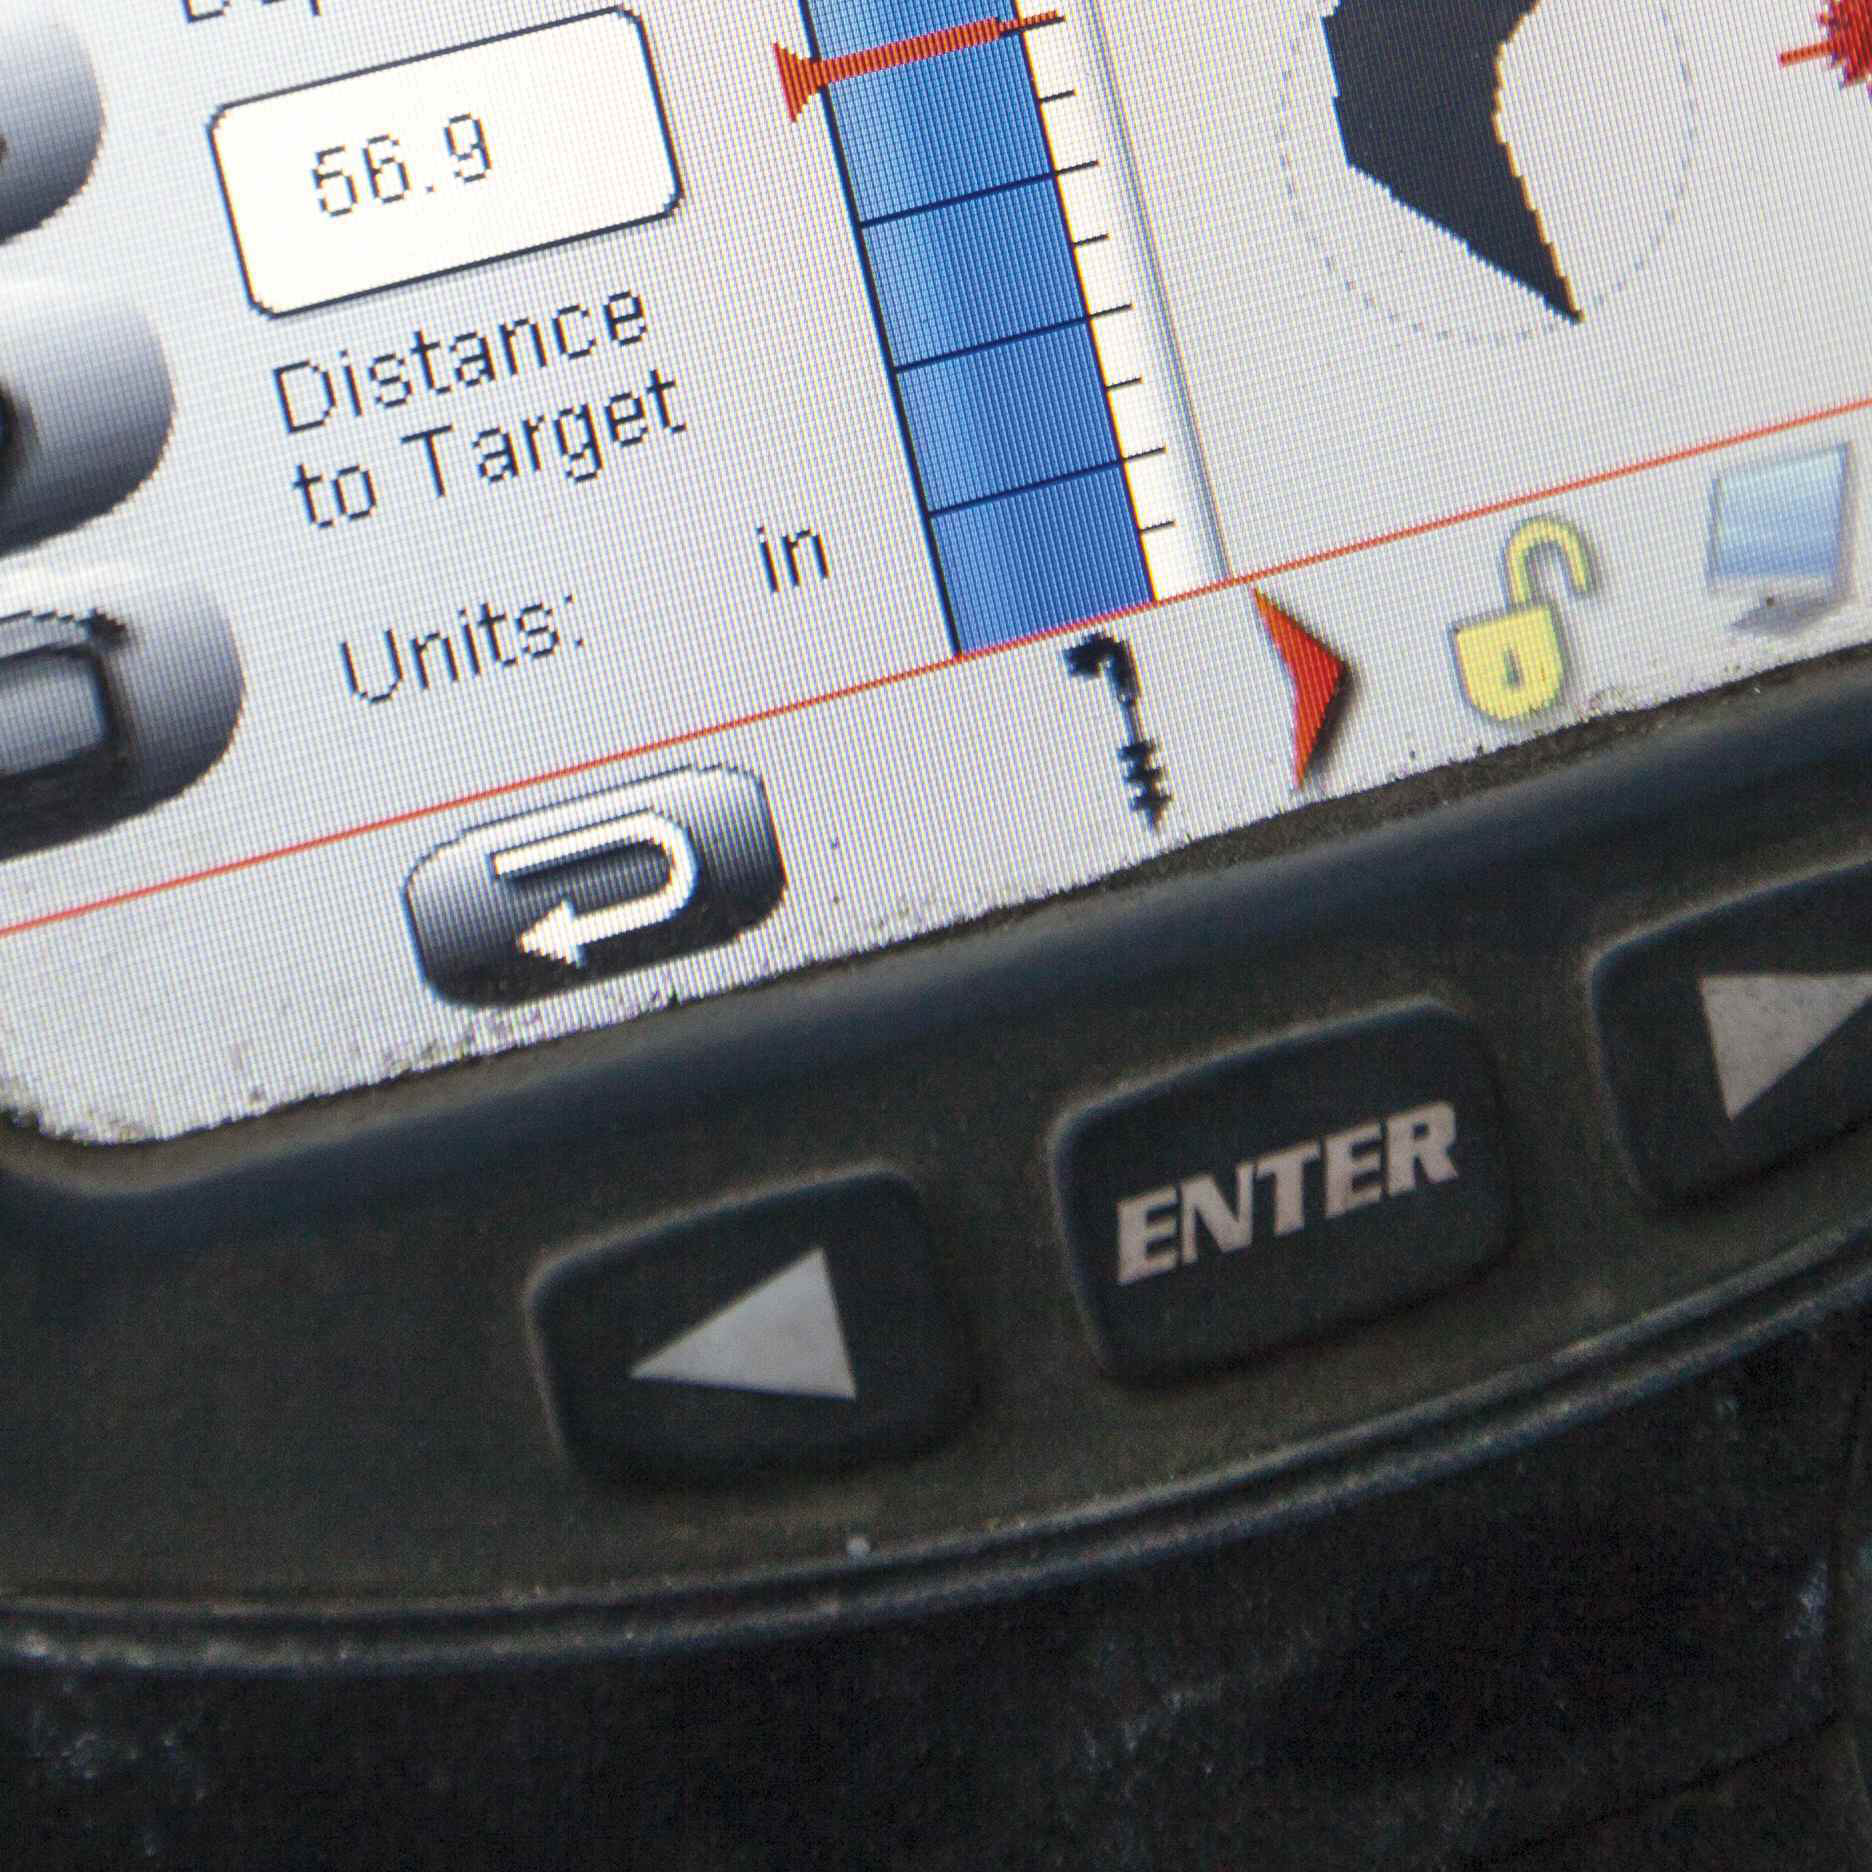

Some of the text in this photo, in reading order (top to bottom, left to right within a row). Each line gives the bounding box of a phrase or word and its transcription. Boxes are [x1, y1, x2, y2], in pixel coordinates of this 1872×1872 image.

[310, 113, 495, 223] 56.9
[271, 288, 650, 433] Distance
[292, 374, 689, 530] to Target
[339, 516, 829, 708] Units: in
[1117, 1102, 1461, 1287] ENTER
